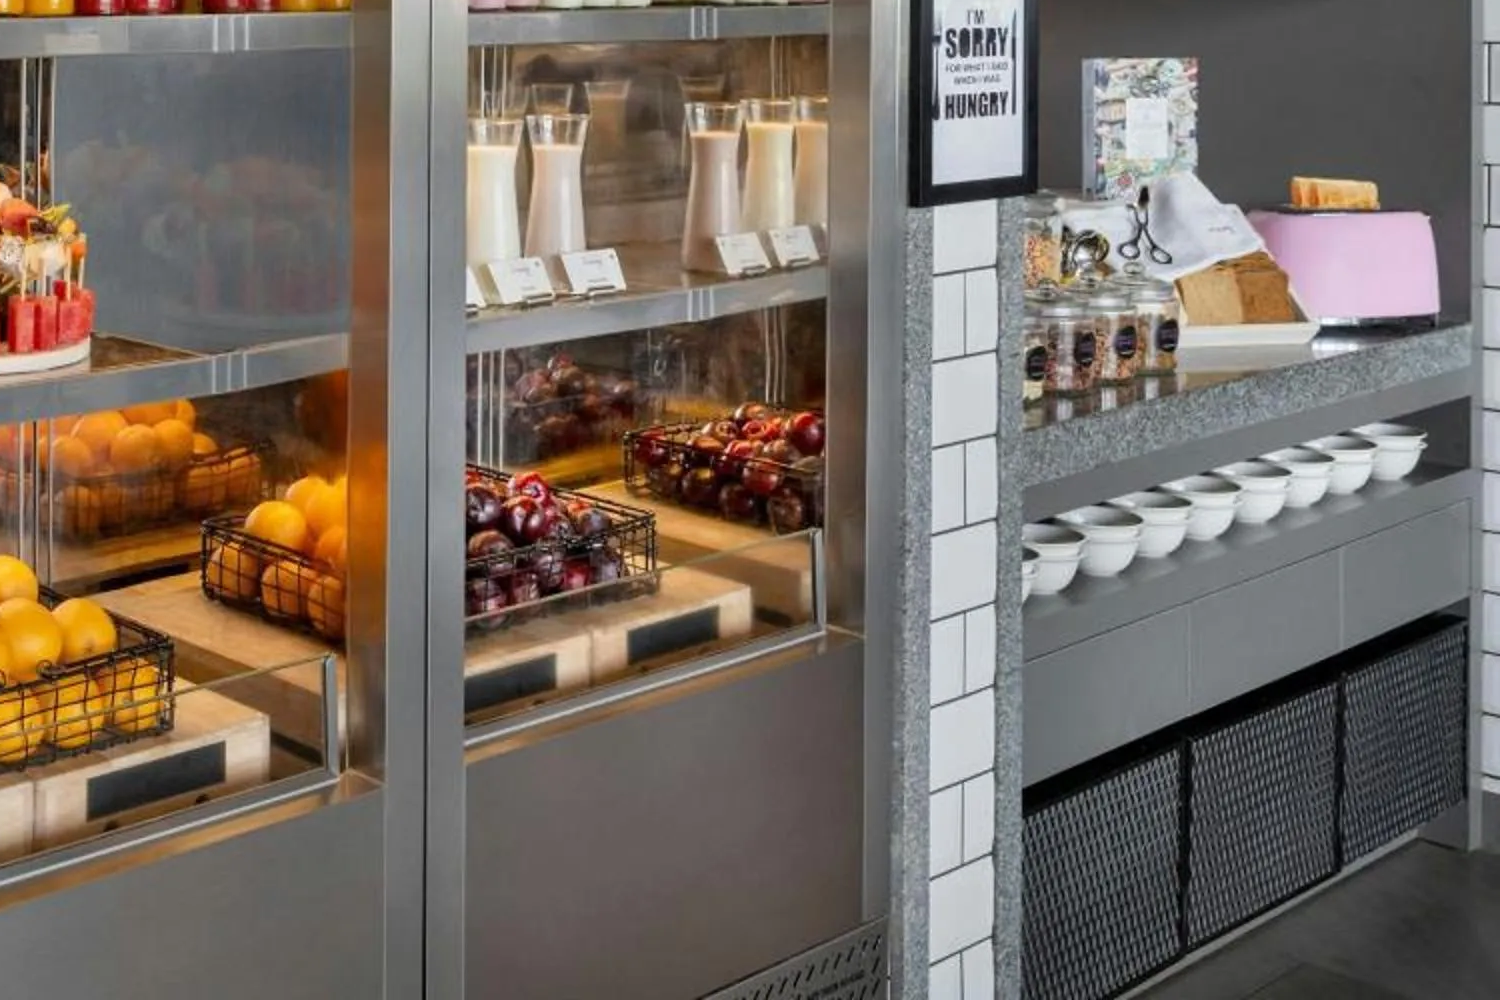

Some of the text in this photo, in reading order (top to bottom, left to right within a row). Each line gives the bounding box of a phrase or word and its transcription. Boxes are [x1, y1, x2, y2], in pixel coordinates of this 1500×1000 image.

[966, 9, 985, 25] I'M
[945, 27, 1009, 59] SORRY
[945, 90, 1009, 120] HUNGRY
